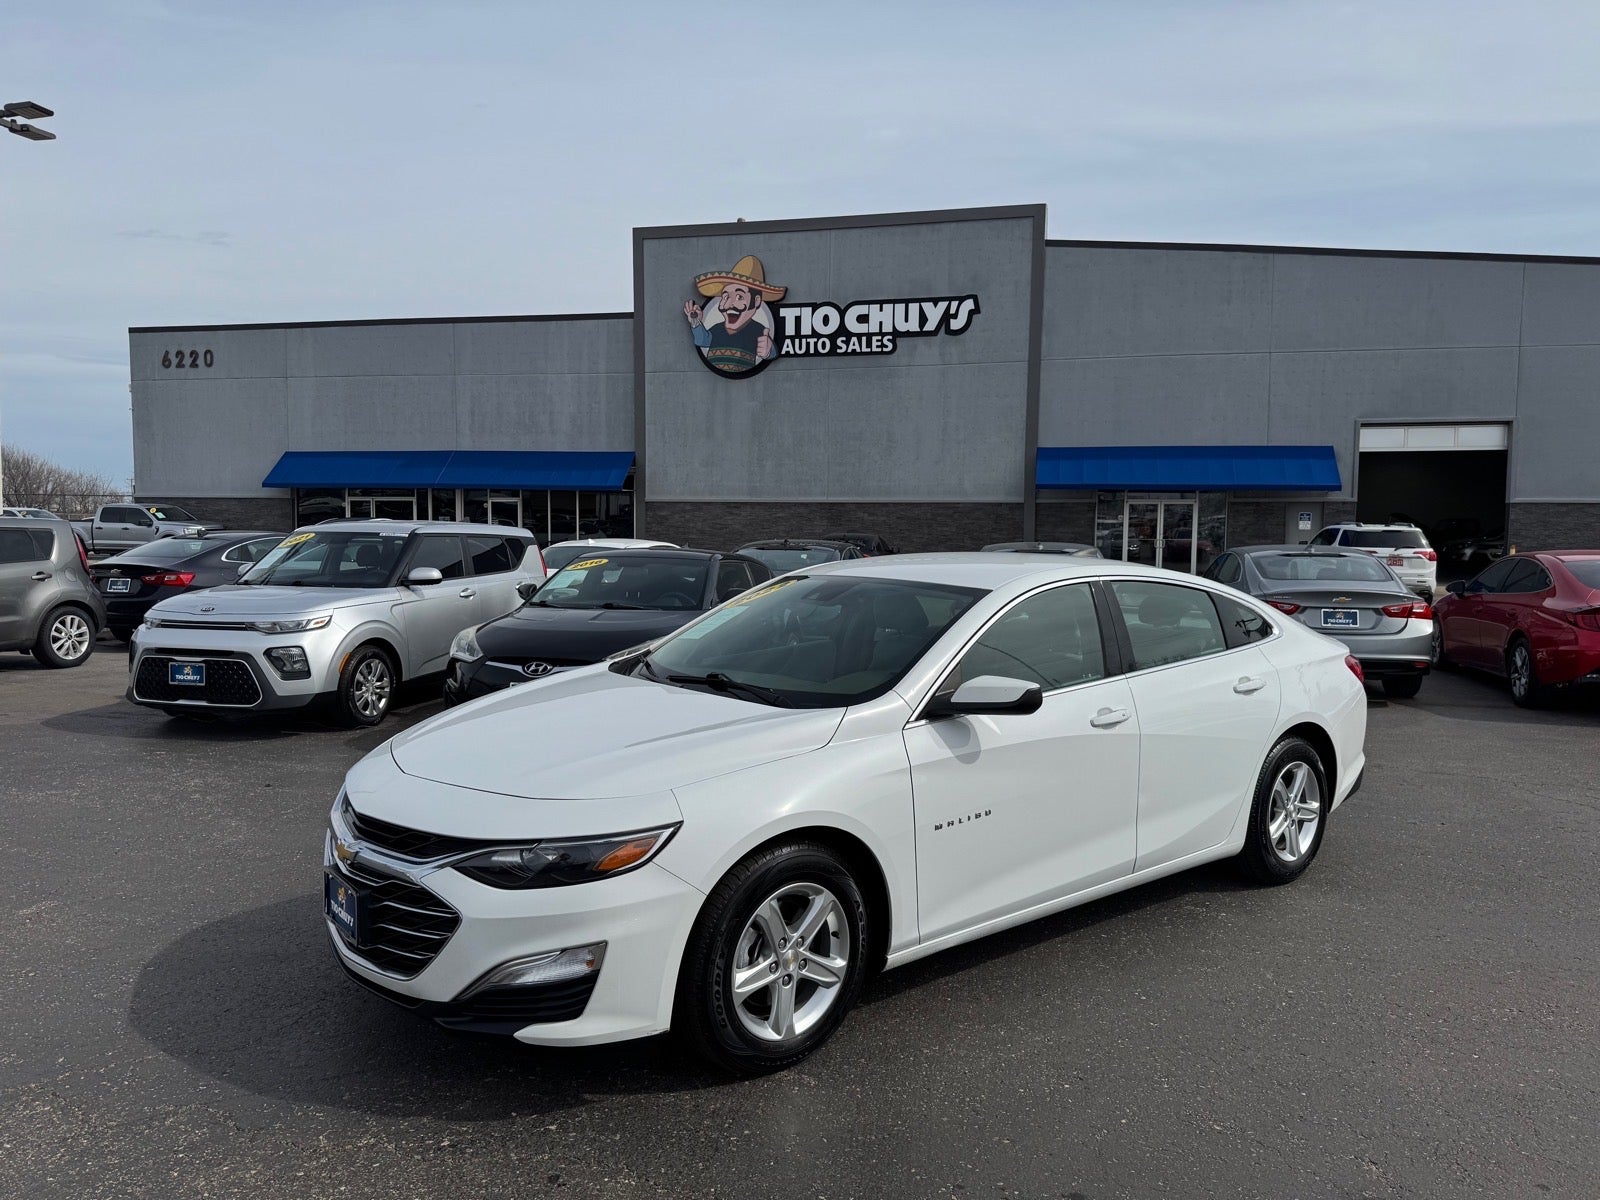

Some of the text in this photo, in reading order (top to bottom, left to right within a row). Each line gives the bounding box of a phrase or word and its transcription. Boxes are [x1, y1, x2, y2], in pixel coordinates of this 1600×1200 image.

[780, 299, 976, 336] TIO CHUY'S
[781, 336, 894, 355] AUTO SALES
[161, 348, 214, 369] 6220
[934, 809, 992, 831] MALIBU
